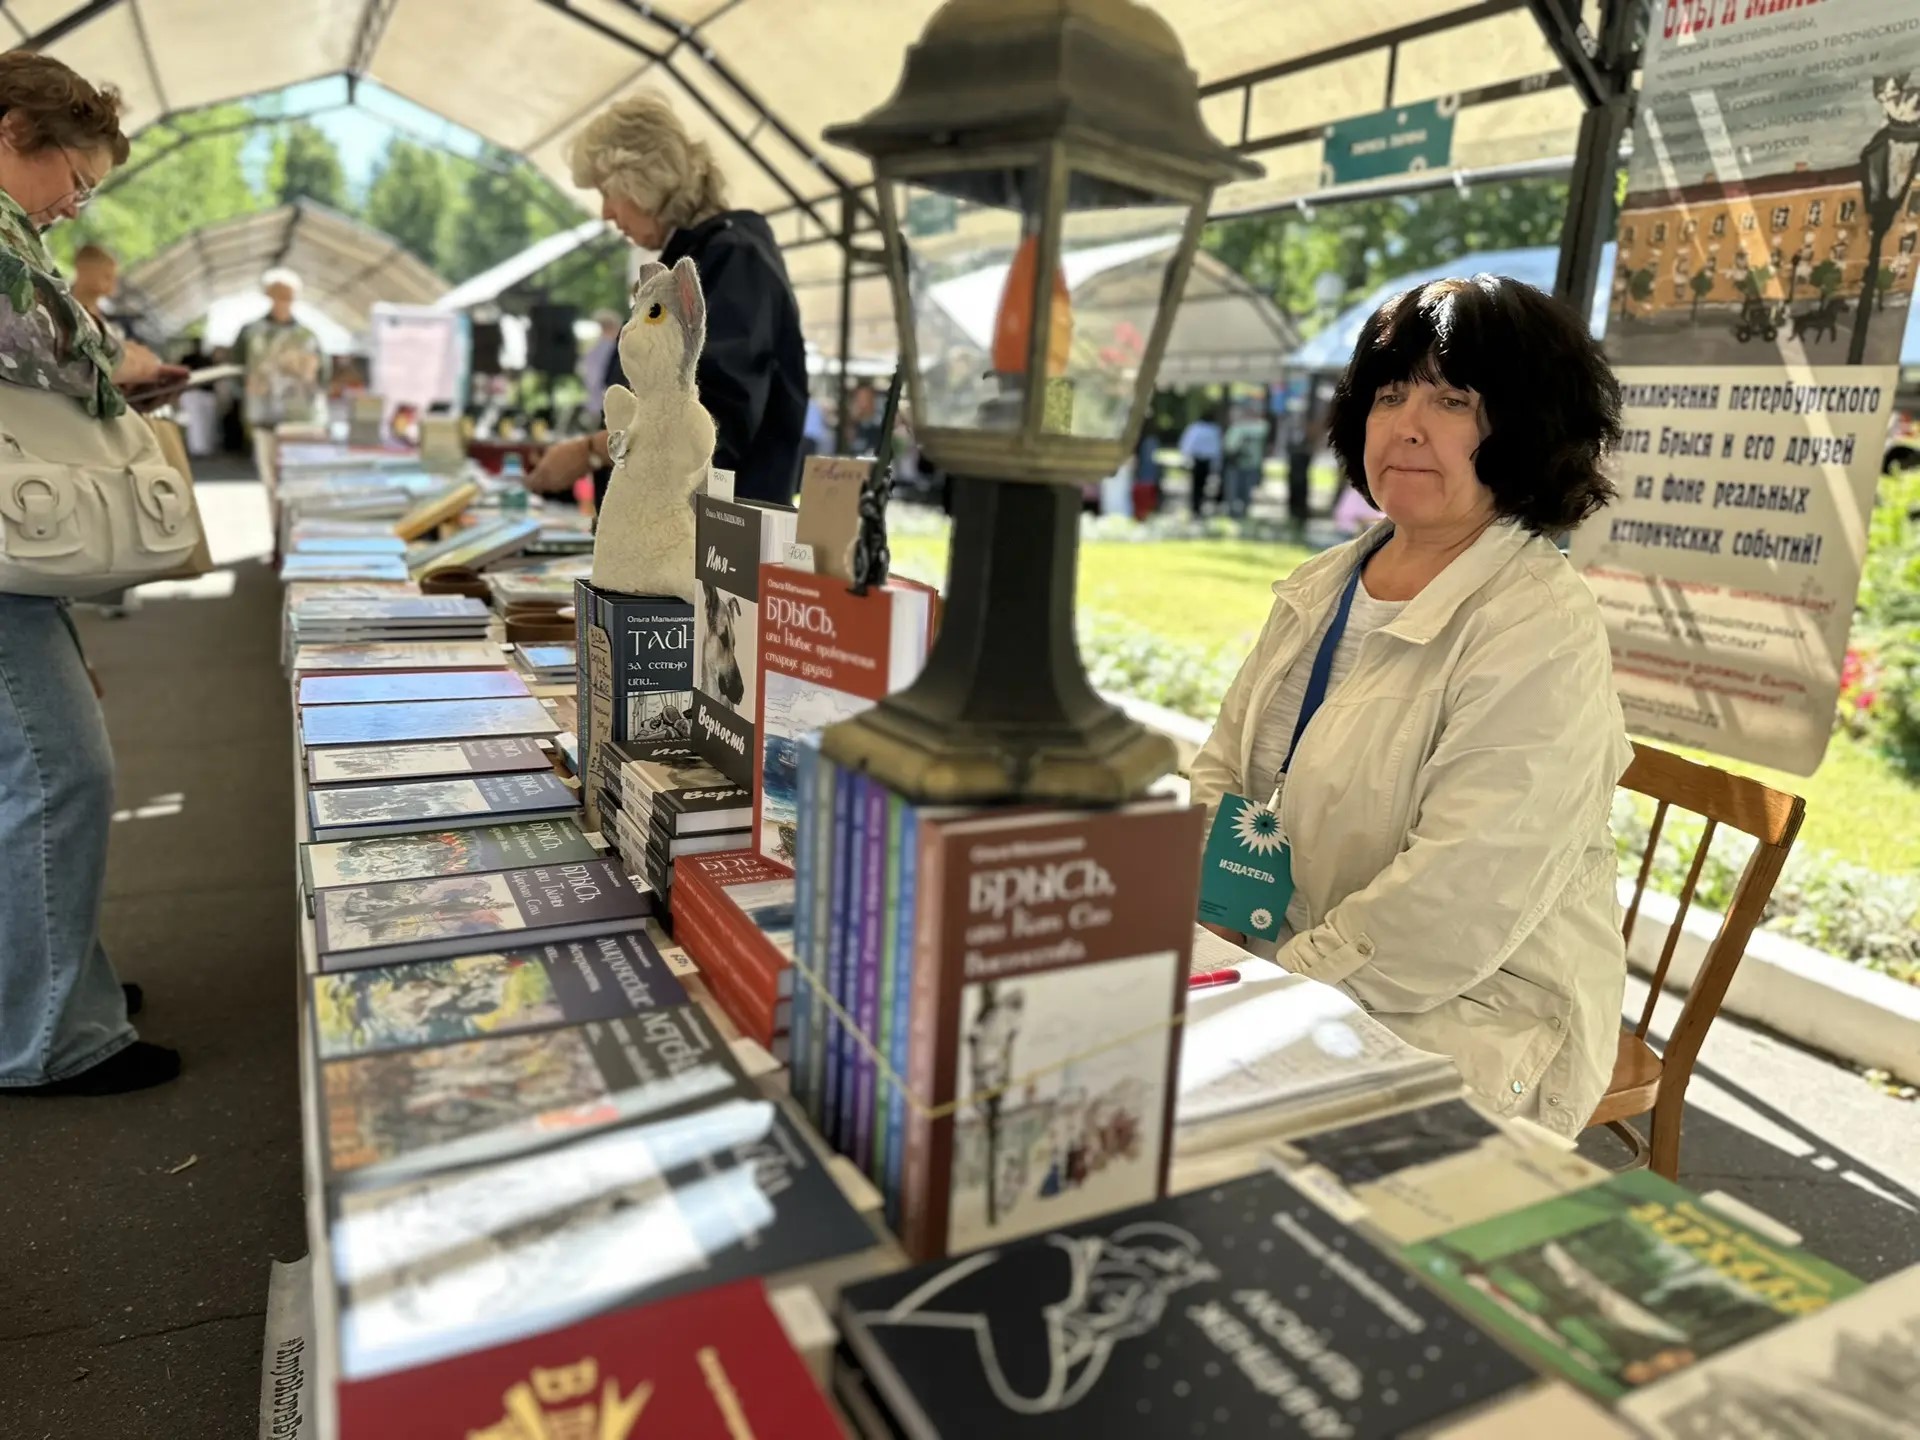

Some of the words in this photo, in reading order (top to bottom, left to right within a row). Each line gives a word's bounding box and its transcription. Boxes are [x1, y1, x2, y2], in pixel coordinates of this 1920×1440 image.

[1620, 384, 1720, 409] риключения
[1729, 381, 1881, 414] петербургского
[1658, 426, 1713, 459] Брыся
[1722, 433, 1734, 460] и
[1744, 434, 1775, 461] его
[1784, 433, 1857, 467] друзей
[1634, 475, 1654, 498] на
[1662, 473, 1705, 505] фоне
[1713, 480, 1811, 514] реальных
[706, 545, 728, 574] Имя
[1609, 517, 1724, 555] исторических
[1732, 528, 1823, 565] событий!
[627, 615, 650, 623] Ольга
[766, 596, 837, 639] БРЫСЬ,
[627, 624, 695, 656] ТАЙН
[627, 661, 642, 670] за
[698, 704, 745, 755] Верность
[557, 865, 601, 904] БРЫСЬ,
[967, 857, 1117, 919] БРЫСЬ,
[1218, 858, 1276, 884] ИЗДАТЕЛЬ
